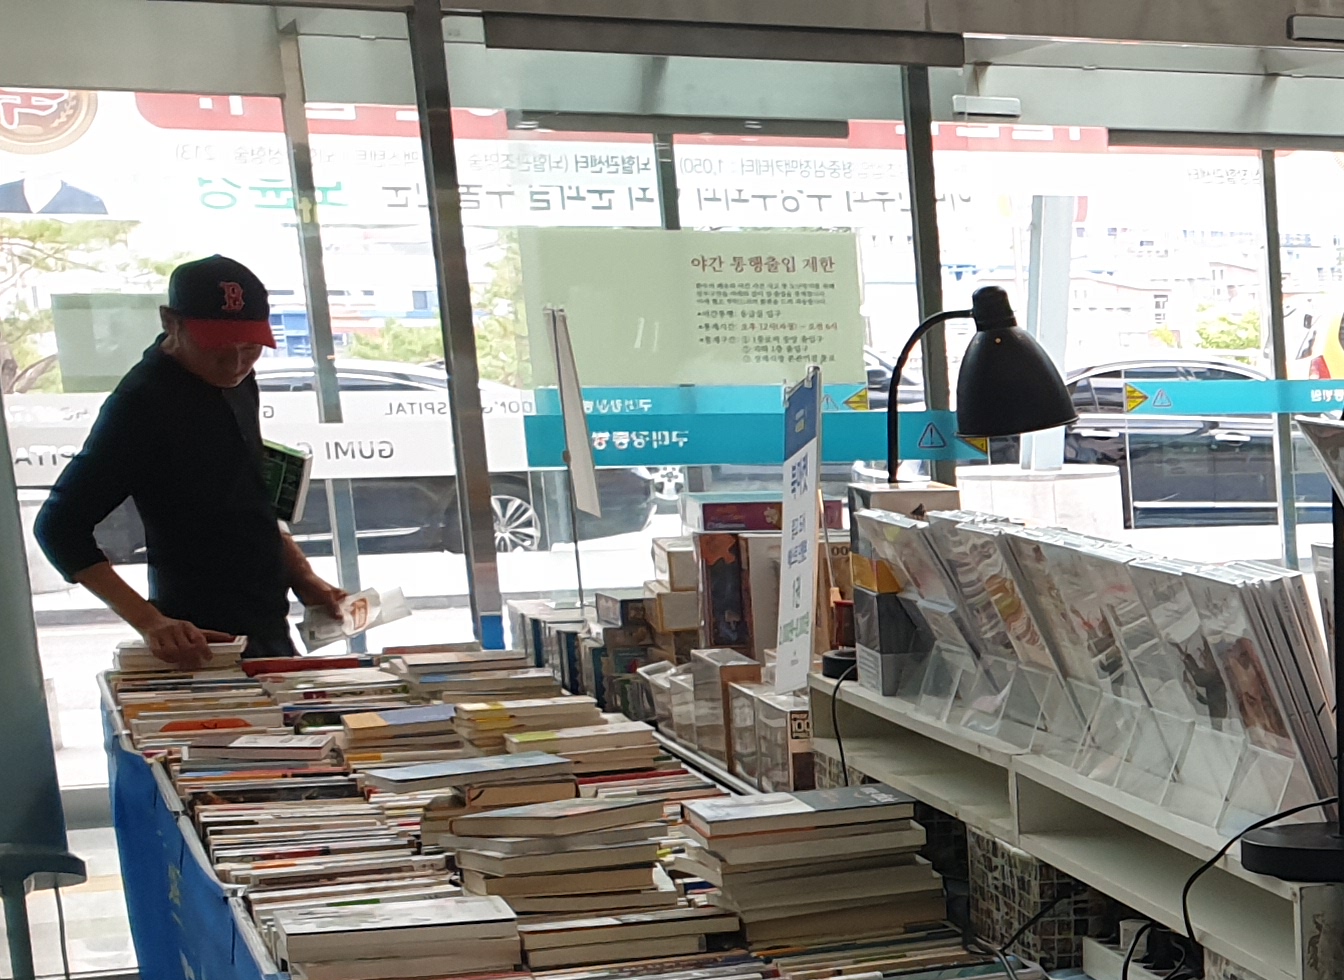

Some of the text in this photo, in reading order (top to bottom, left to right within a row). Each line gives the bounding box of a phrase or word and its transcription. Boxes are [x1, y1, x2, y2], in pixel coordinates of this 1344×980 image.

[691, 255, 835, 273] 야간 통행출입 제한
